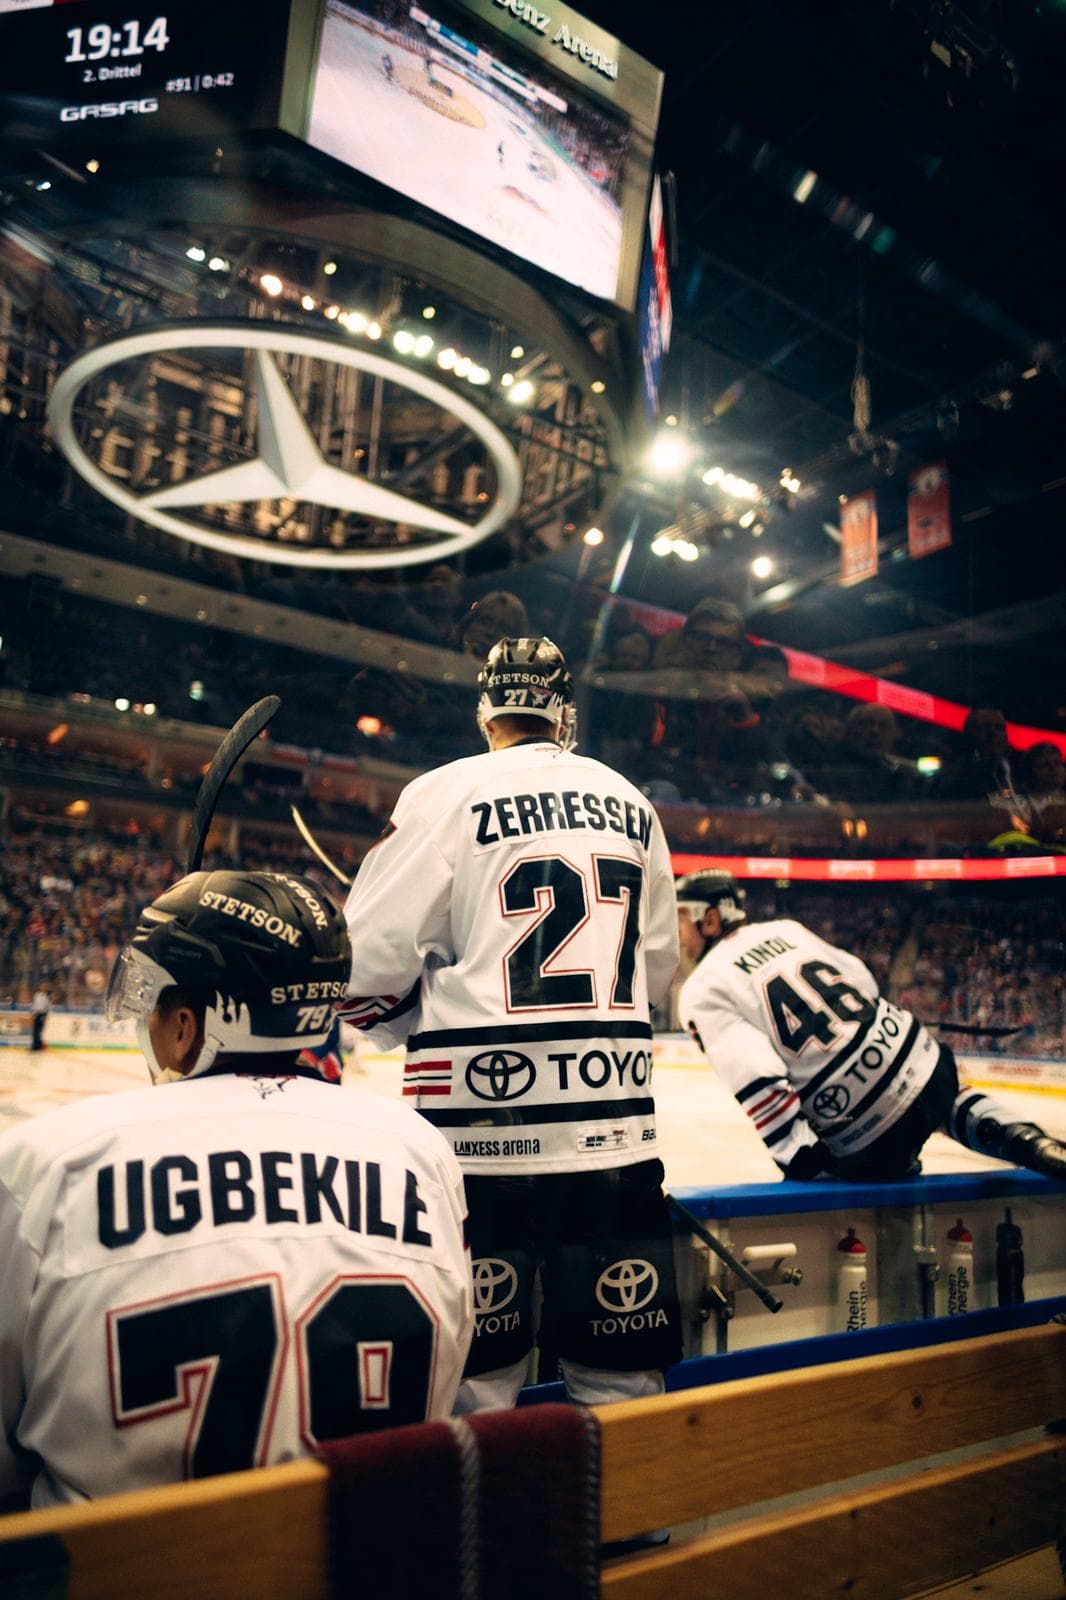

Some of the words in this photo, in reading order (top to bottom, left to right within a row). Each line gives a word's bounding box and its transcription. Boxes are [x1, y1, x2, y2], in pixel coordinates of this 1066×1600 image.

[65, 17, 170, 62] 19:14
[552, 24, 618, 80] Arena
[83, 69, 97, 83] 2.
[98, 62, 143, 81] Drittel
[165, 77, 192, 93] #91
[488, 673, 550, 688] STETSON
[504, 689, 528, 706] 27
[471, 791, 652, 850] ZERRESSEN
[199, 891, 302, 946] STETSON
[499, 854, 645, 1014] 27
[733, 936, 798, 975] KINDL
[295, 1004, 330, 1033] 79
[762, 956, 878, 1058] 46
[548, 1050, 653, 1090] TOYO
[454, 1140, 500, 1157] LANXESS
[502, 1138, 540, 1156] arena
[96, 1150, 433, 1249] UGBEKILE
[957, 1265, 970, 1314] nergie
[474, 1311, 521, 1337] YOTA
[590, 1309, 668, 1336] TOYOTA
